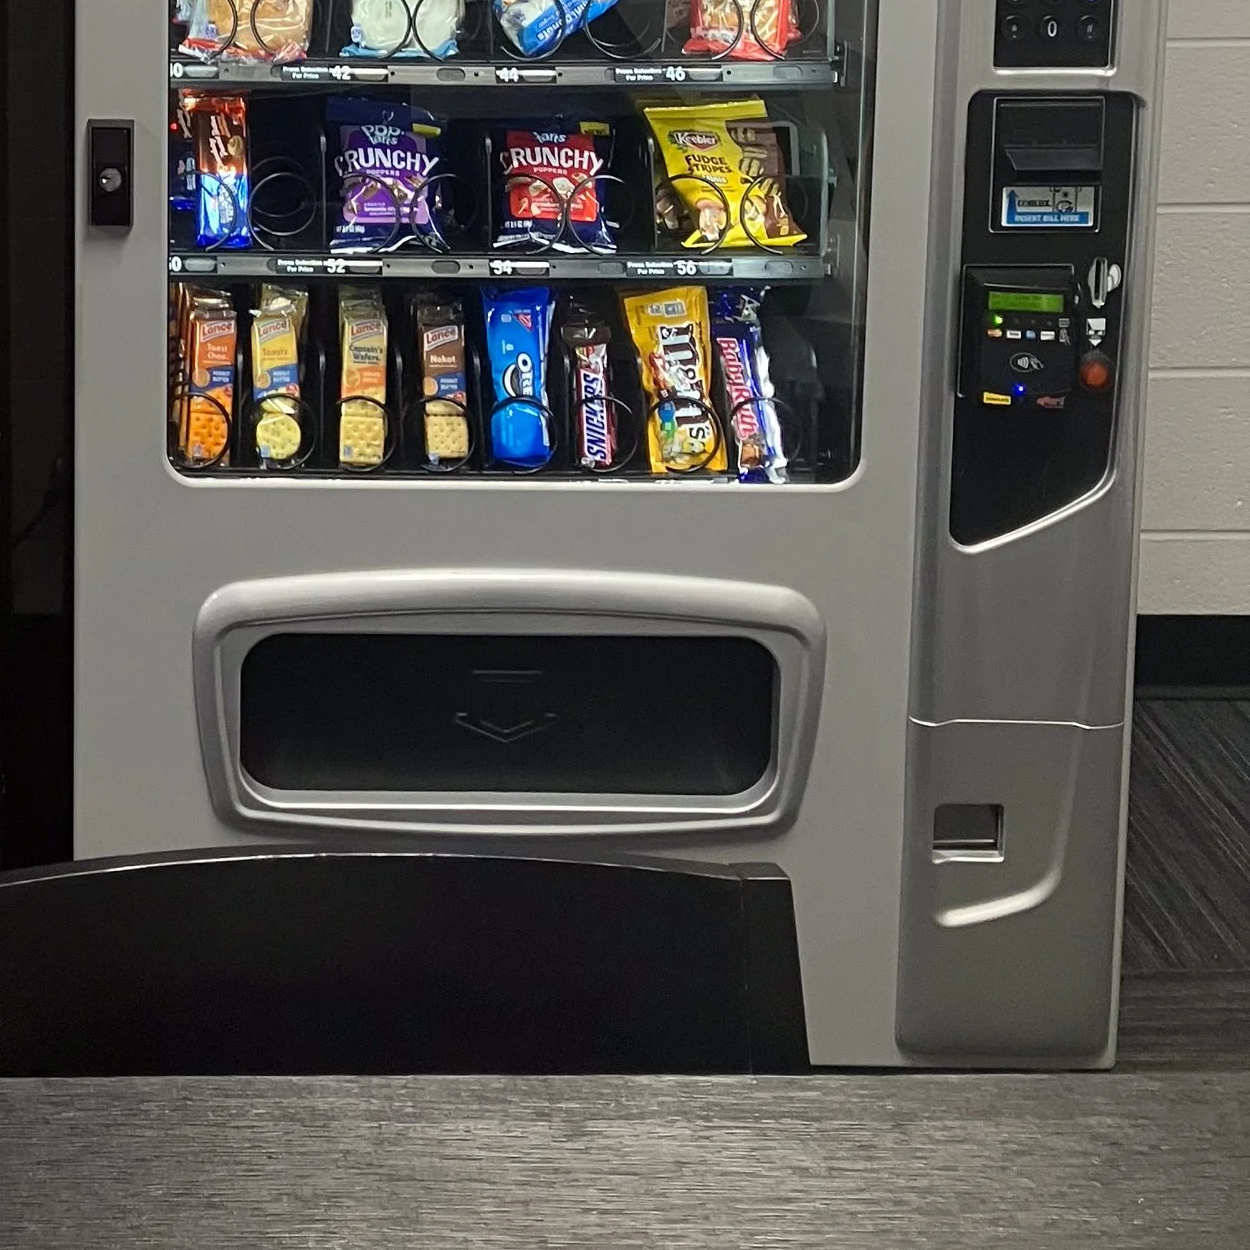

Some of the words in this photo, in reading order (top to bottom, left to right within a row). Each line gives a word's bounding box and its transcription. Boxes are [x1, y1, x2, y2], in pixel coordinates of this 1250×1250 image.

[1048, 21, 1058, 37] 0
[666, 67, 685, 81] 46
[677, 132, 716, 145] Keebler
[334, 147, 439, 177] CRUNCHY
[500, 146, 604, 176] CRUNCHY
[684, 154, 728, 166] FUDGE
[688, 163, 732, 175] STRIPES
[677, 261, 696, 275] 56
[202, 321, 232, 337] Lance
[259, 321, 289, 336] Lance
[351, 323, 382, 336] Lance
[426, 328, 457, 344] Lance
[430, 354, 456, 364] Nekot
[583, 372, 607, 461] SNICKERS
